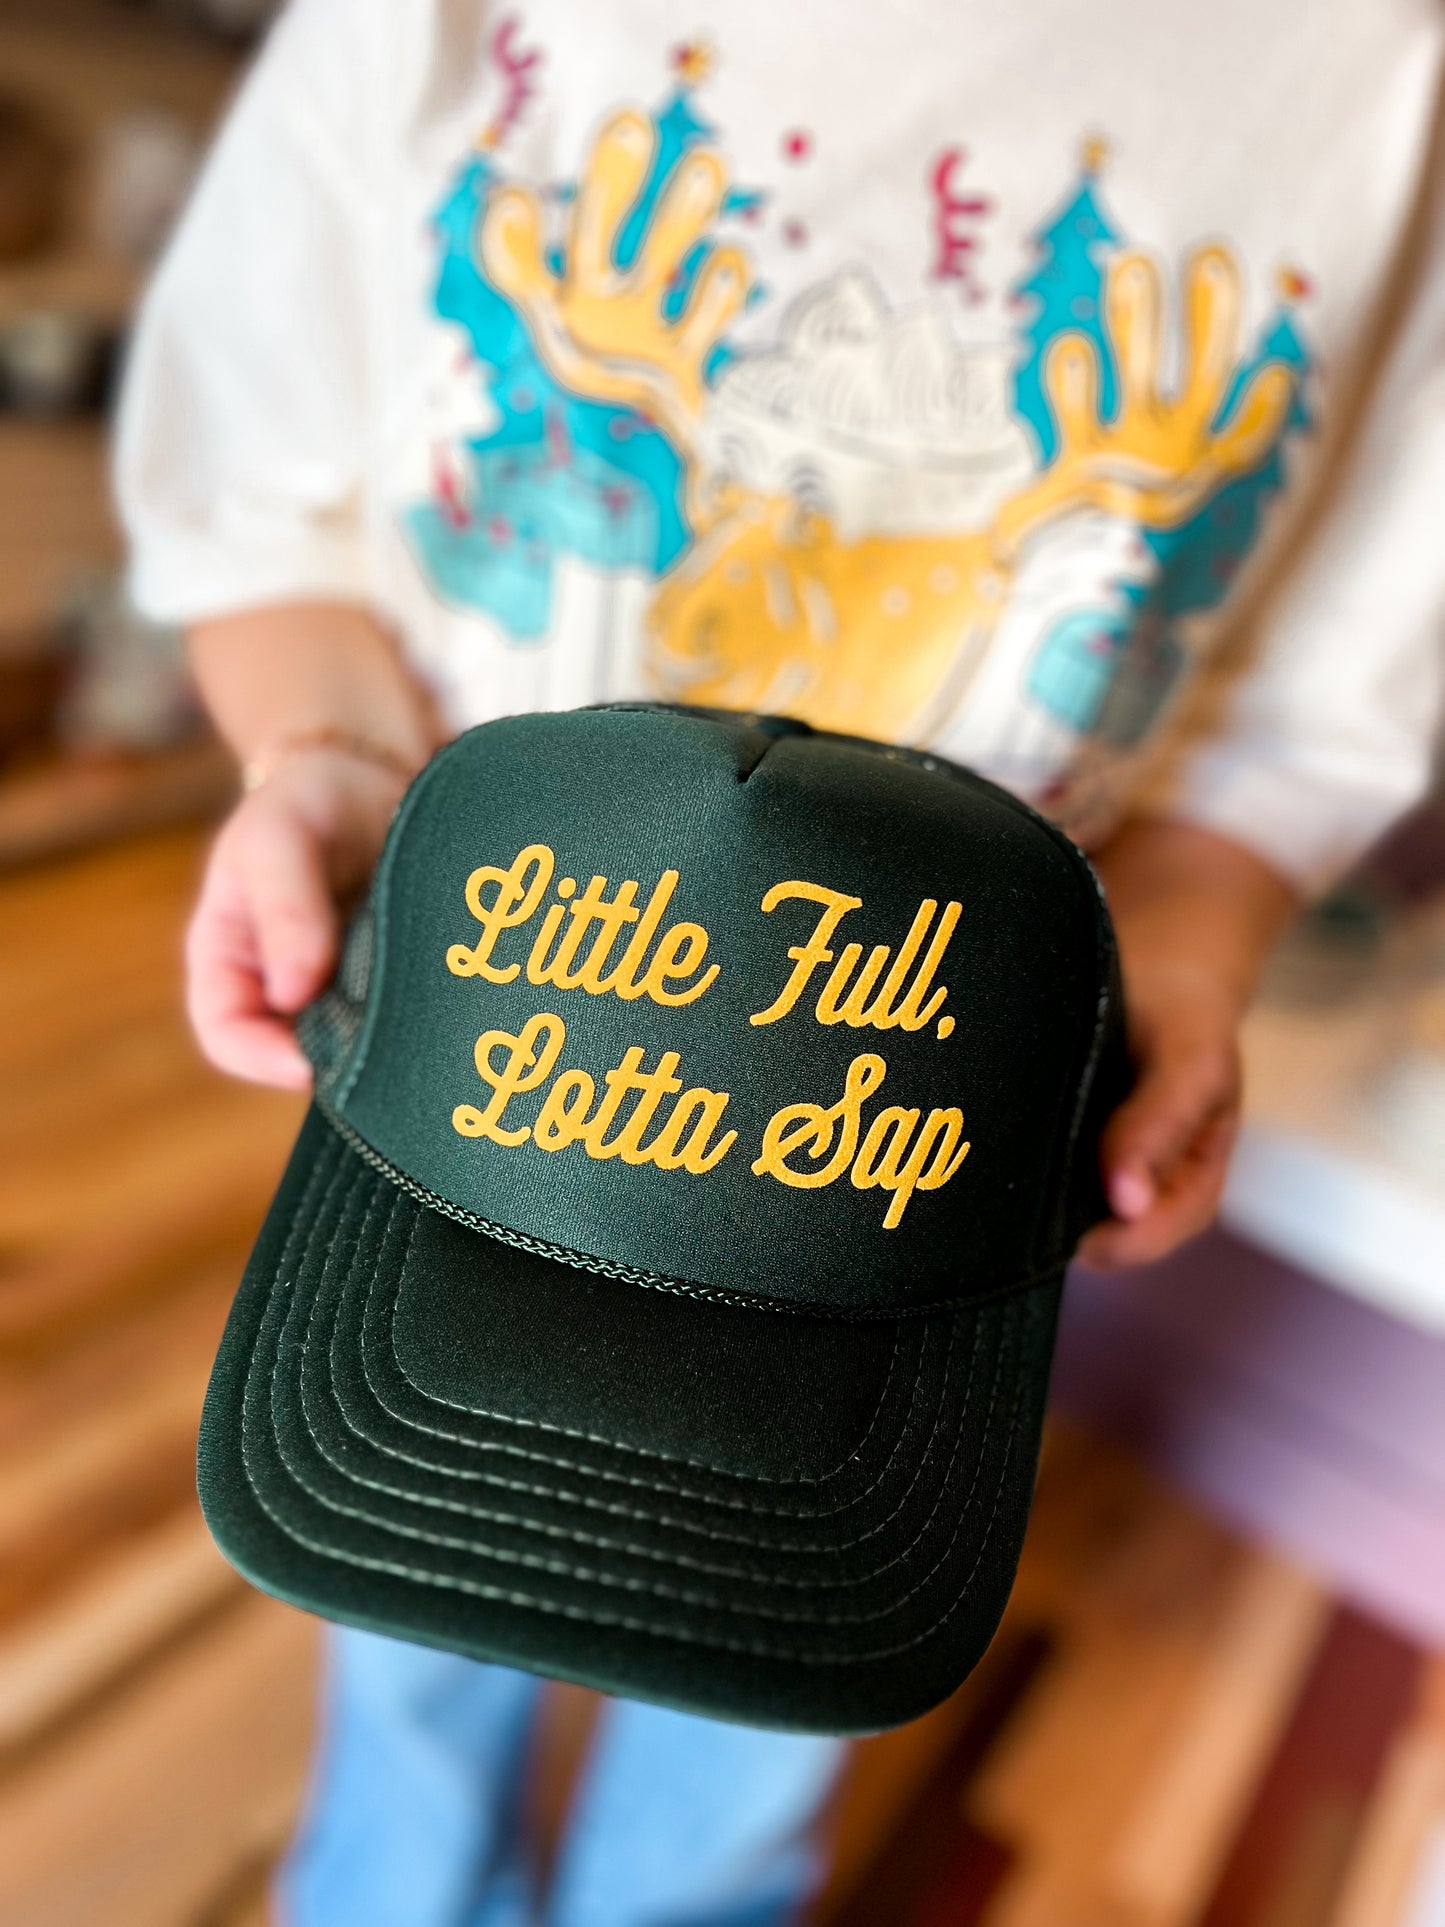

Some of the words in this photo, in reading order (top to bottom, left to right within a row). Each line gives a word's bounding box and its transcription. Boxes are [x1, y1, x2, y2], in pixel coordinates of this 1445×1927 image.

[446, 844, 720, 1008] Little
[750, 880, 963, 1040] Full,
[453, 1013, 738, 1176] Lotta
[752, 1053, 970, 1230] Sap
